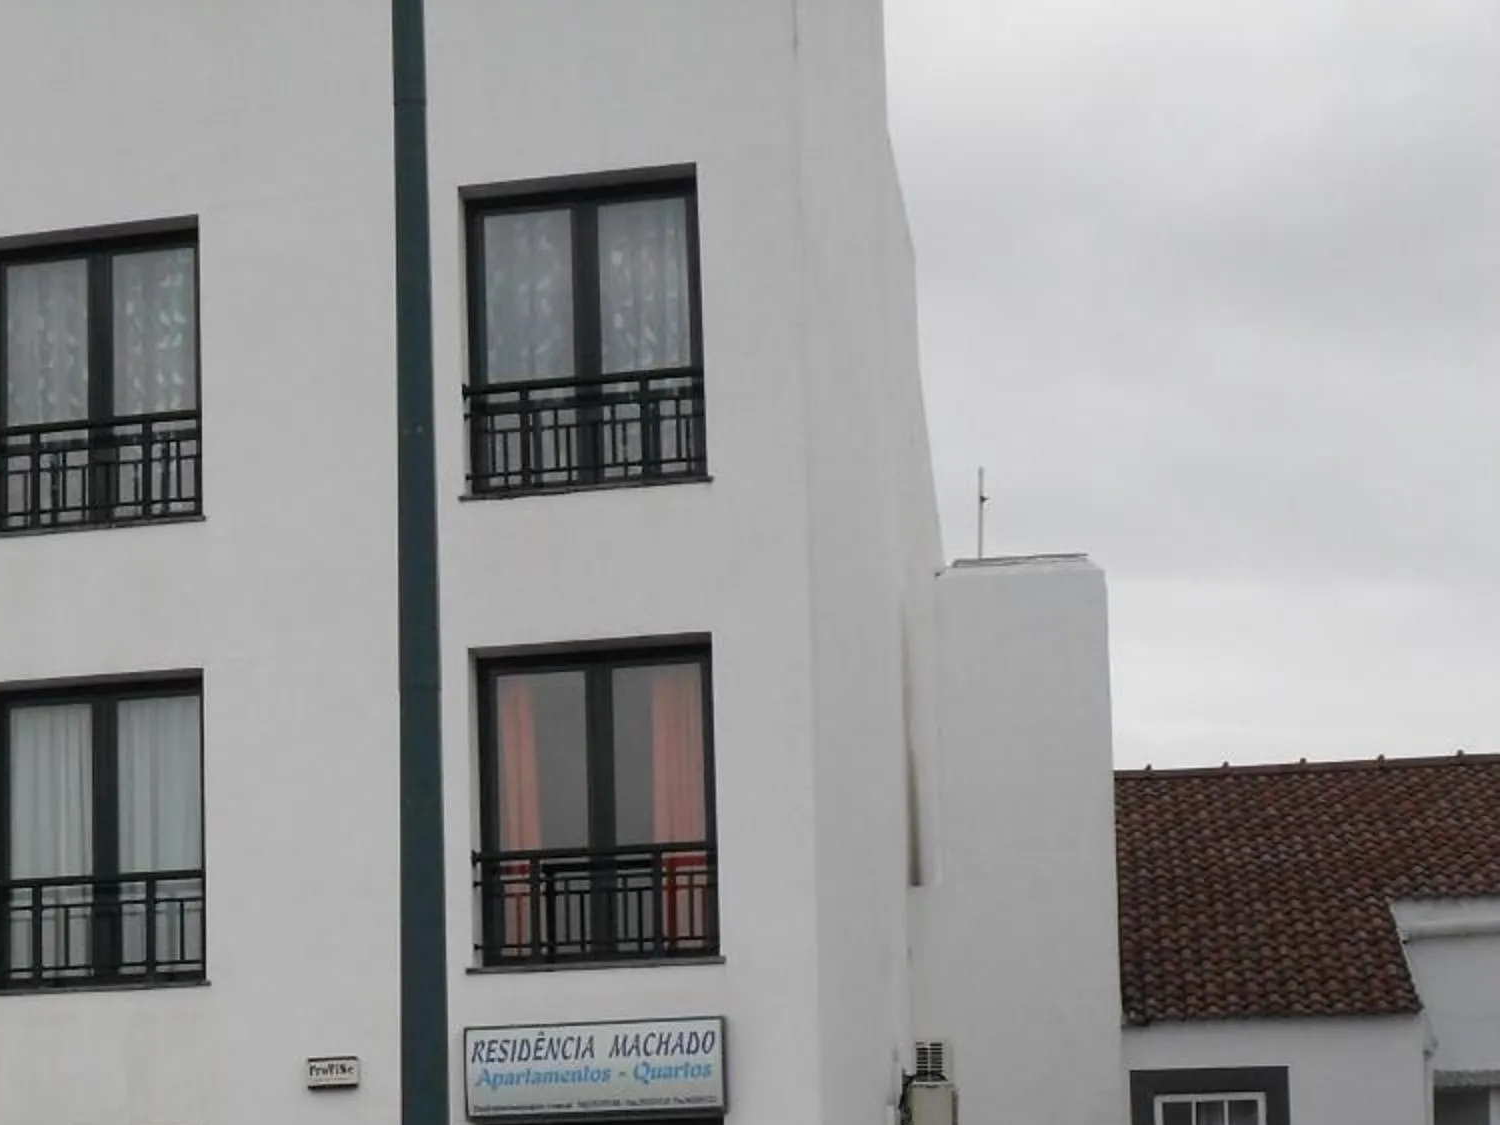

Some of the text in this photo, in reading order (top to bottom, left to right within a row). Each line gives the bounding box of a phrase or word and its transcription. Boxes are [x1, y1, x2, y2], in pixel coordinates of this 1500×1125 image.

[471, 1030, 716, 1064] RESIDÊNCIA MACHADO
[474, 1065, 611, 1091] Apartamentos
[632, 1061, 712, 1085] Quartos
